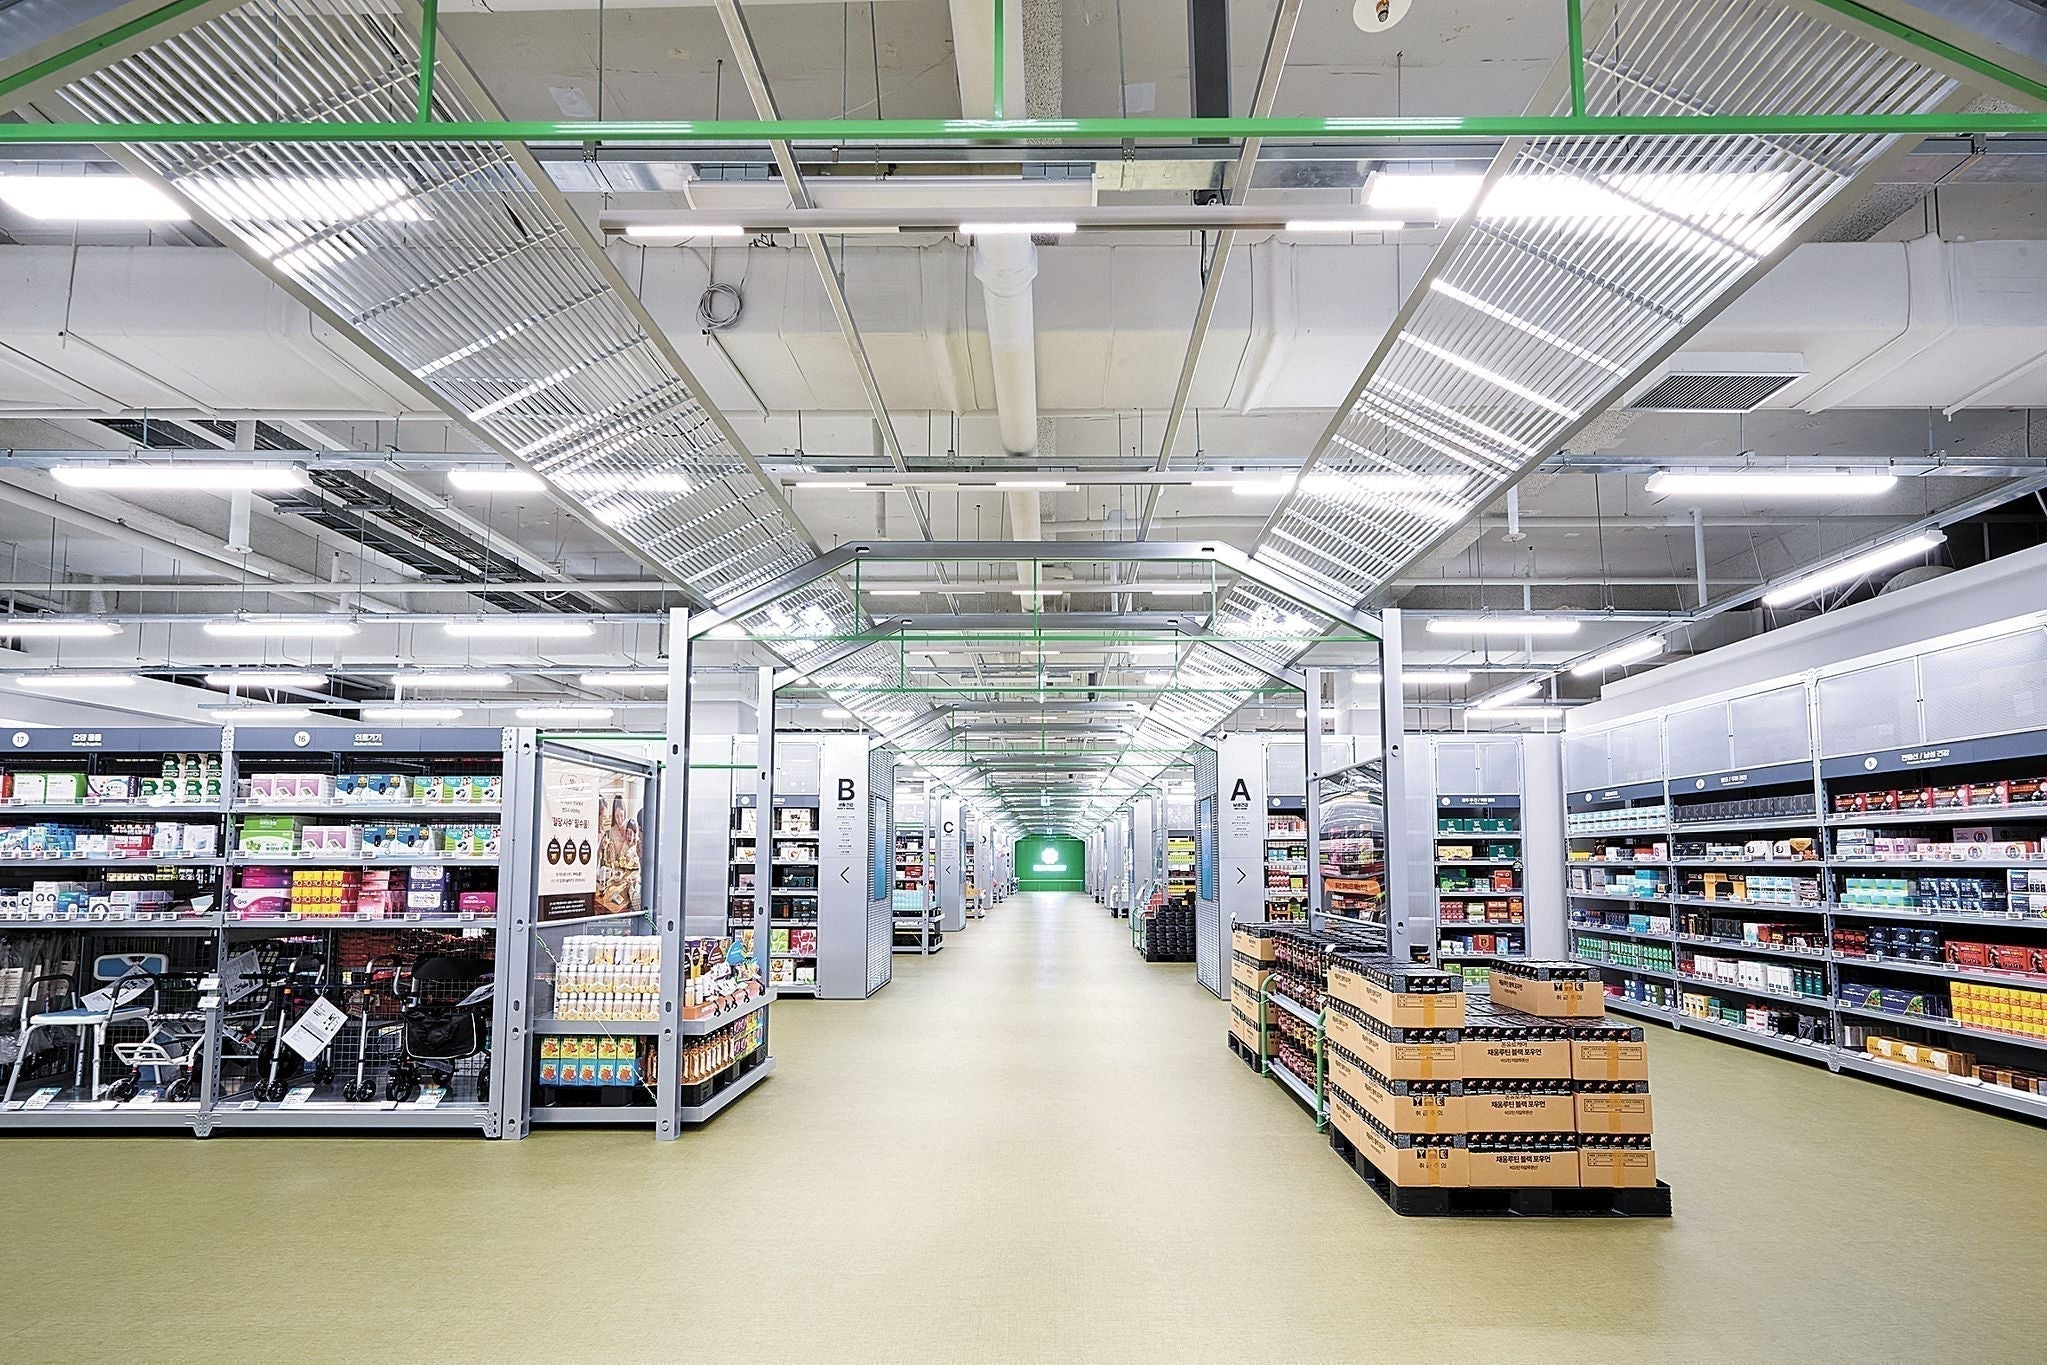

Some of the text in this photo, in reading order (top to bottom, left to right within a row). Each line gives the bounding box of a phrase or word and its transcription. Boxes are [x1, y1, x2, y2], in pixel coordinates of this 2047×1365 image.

[838, 778, 855, 801] B
[1230, 778, 1251, 801] A
[943, 821, 954, 833] C
[1487, 1048, 1511, 1056] 채움루틴
[1511, 1048, 1524, 1056] 블랙
[1491, 1100, 1515, 1108] 채움루틴
[1515, 1100, 1528, 1108] 블랙
[1496, 1155, 1520, 1163] 채움루틴
[1520, 1155, 1533, 1163] 블랙
